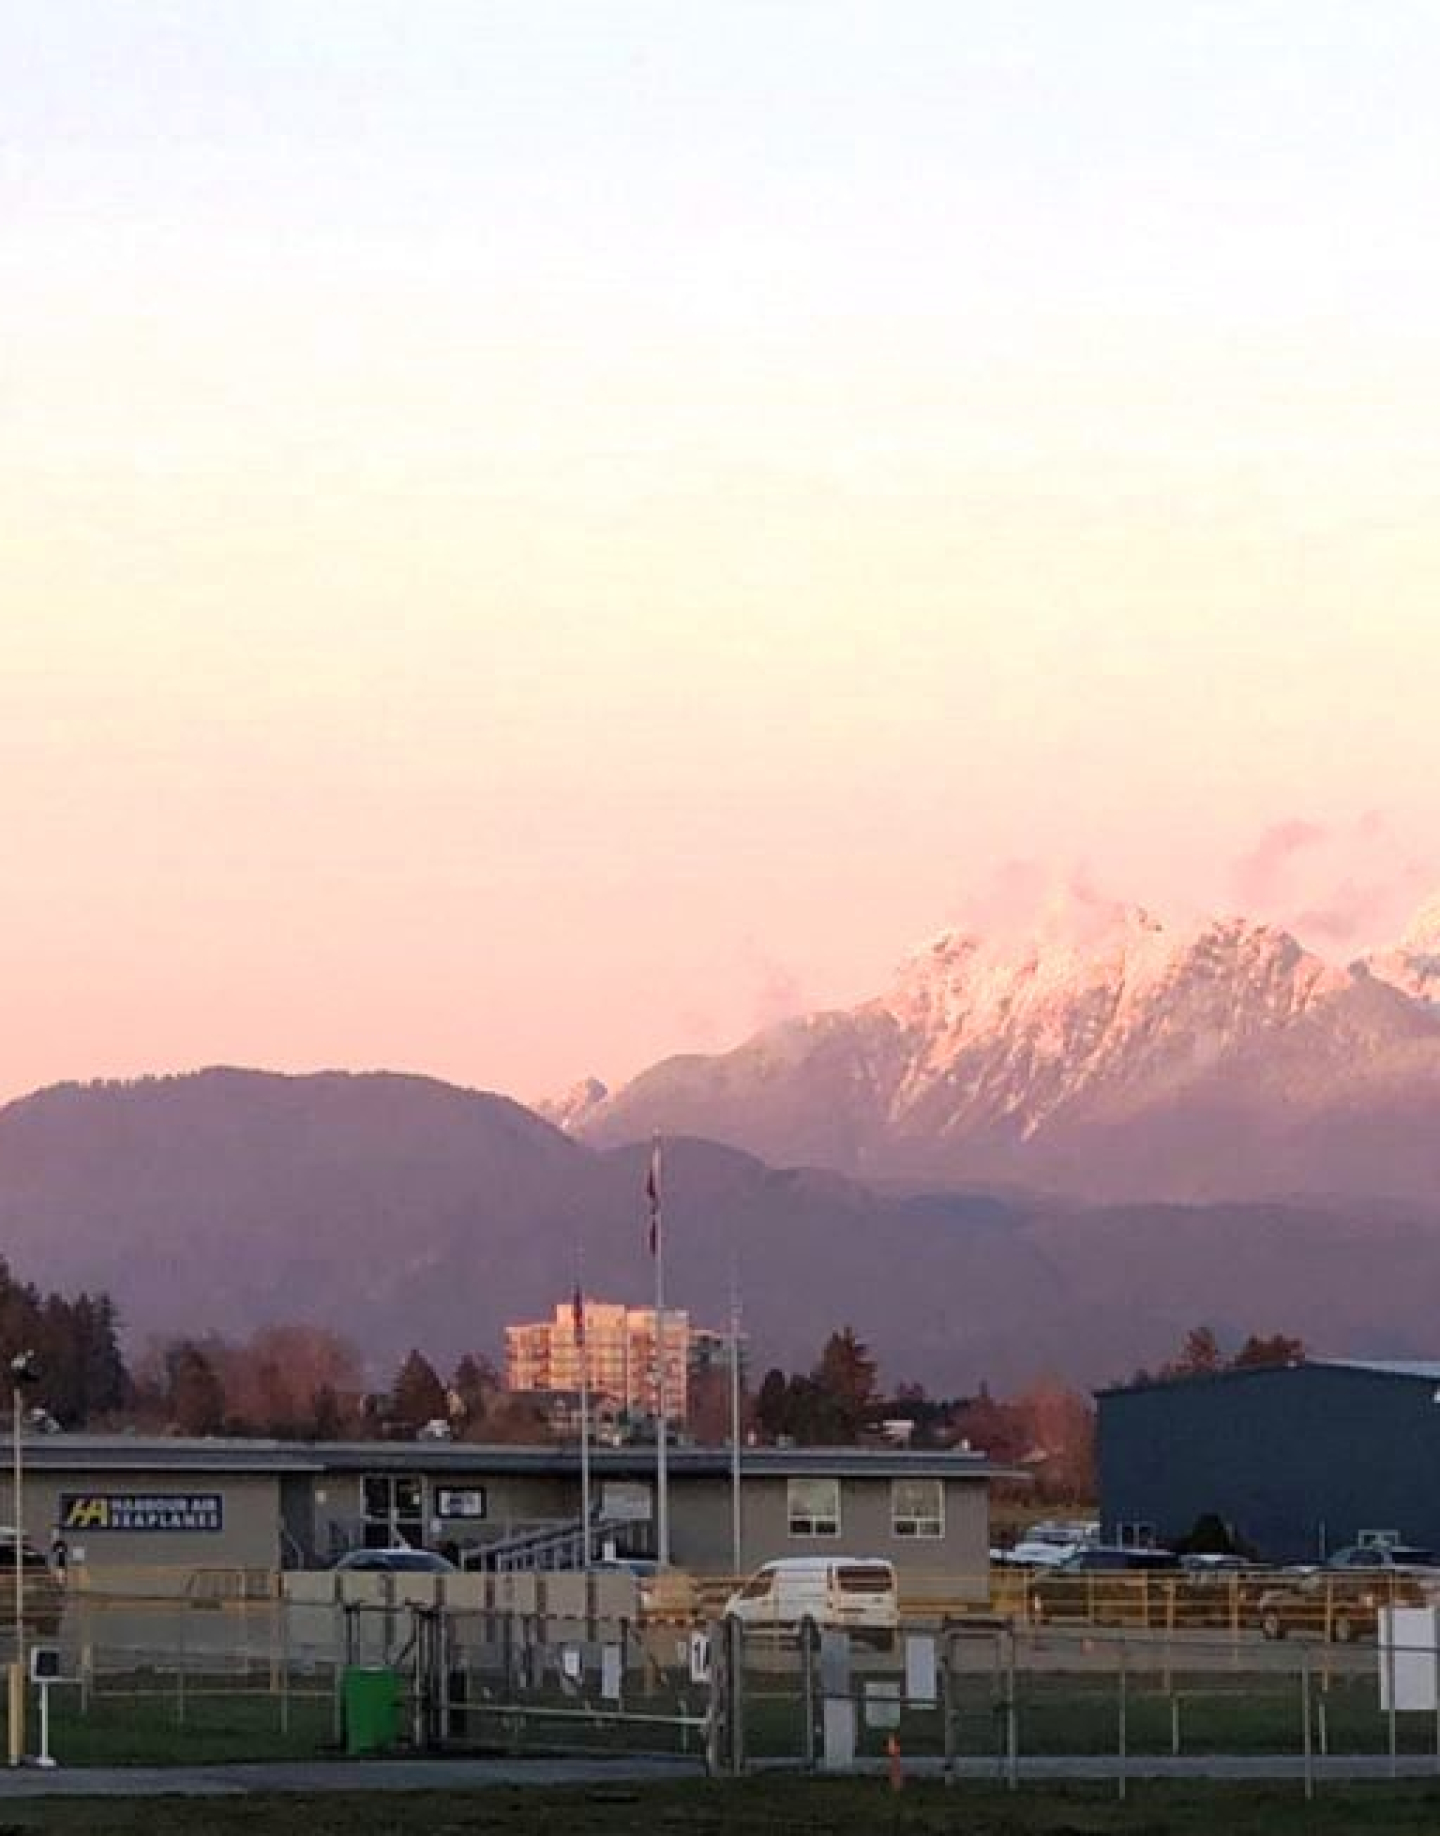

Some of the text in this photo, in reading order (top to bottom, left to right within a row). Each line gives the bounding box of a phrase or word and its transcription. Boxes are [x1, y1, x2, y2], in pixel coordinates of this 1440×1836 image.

[112, 1498, 217, 1511] HARBOUR AIR
[112, 1512, 217, 1527] SEAPLANES
